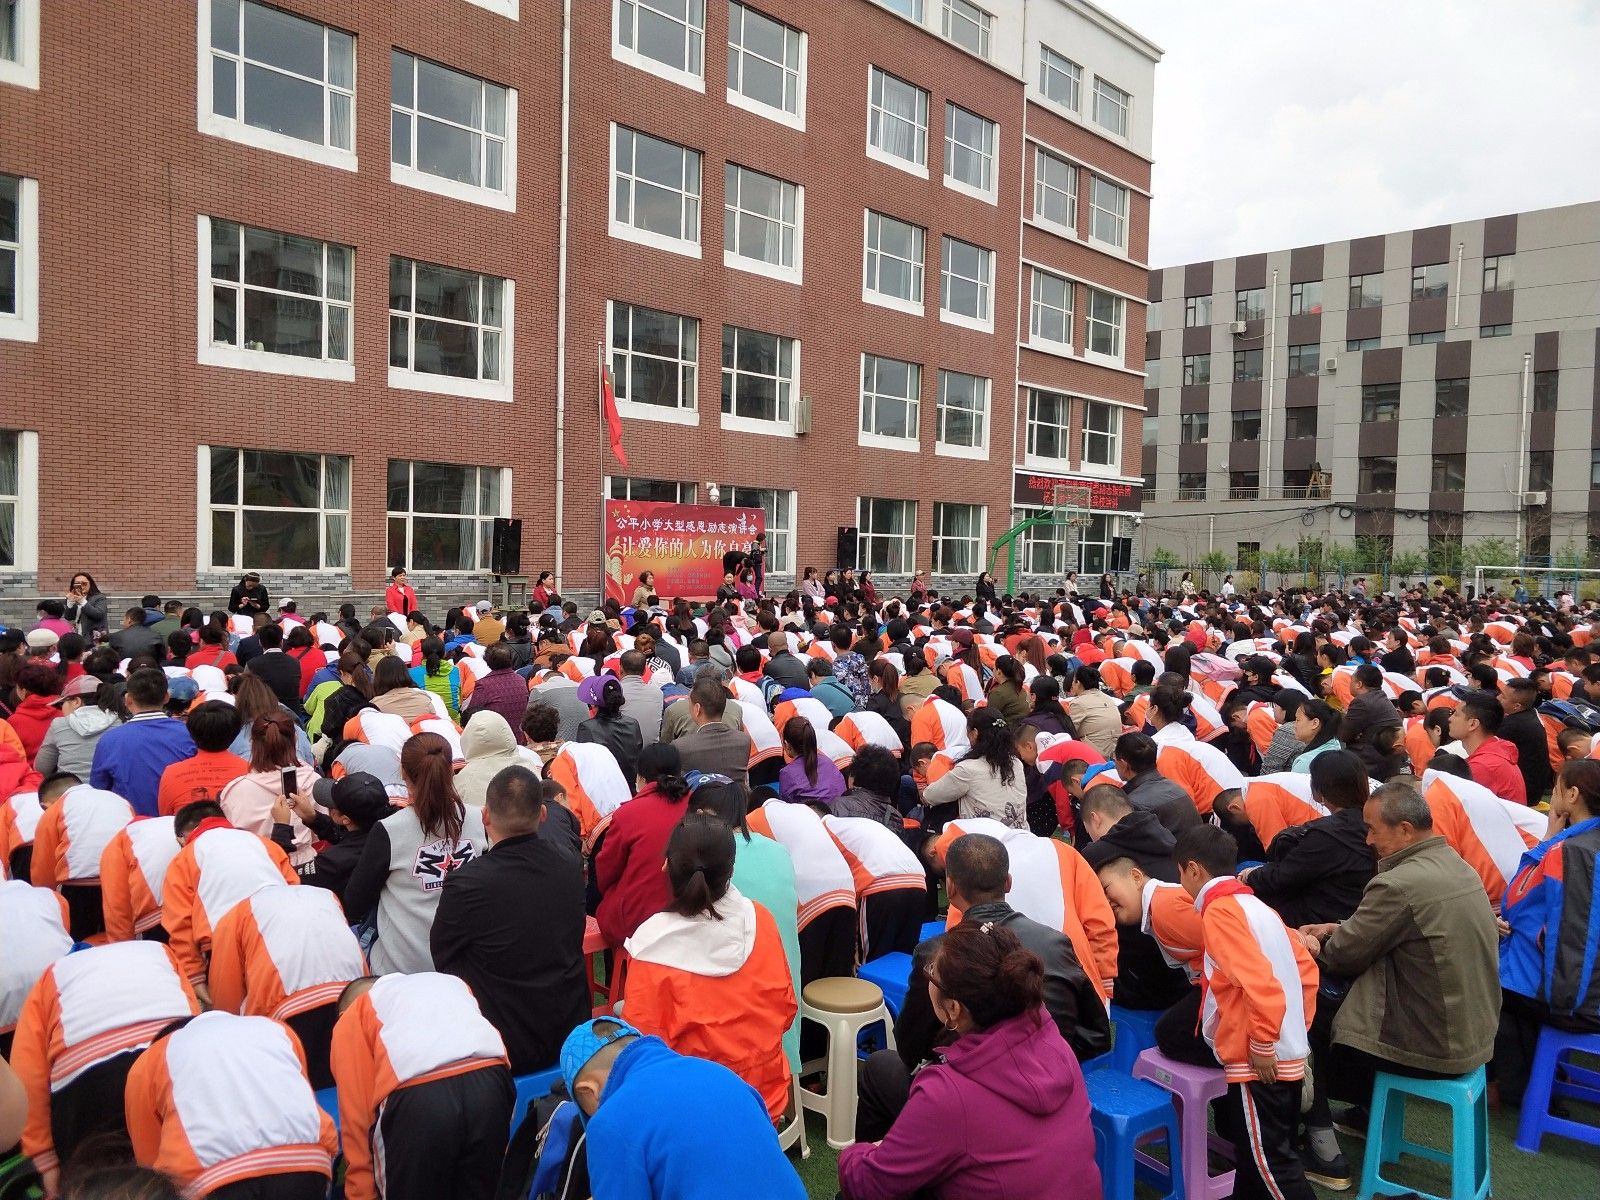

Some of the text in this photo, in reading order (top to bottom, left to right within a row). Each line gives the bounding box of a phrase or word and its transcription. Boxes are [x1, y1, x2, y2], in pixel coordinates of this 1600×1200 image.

[616, 512, 758, 536] 公平小学大型感恩励志演讲会
